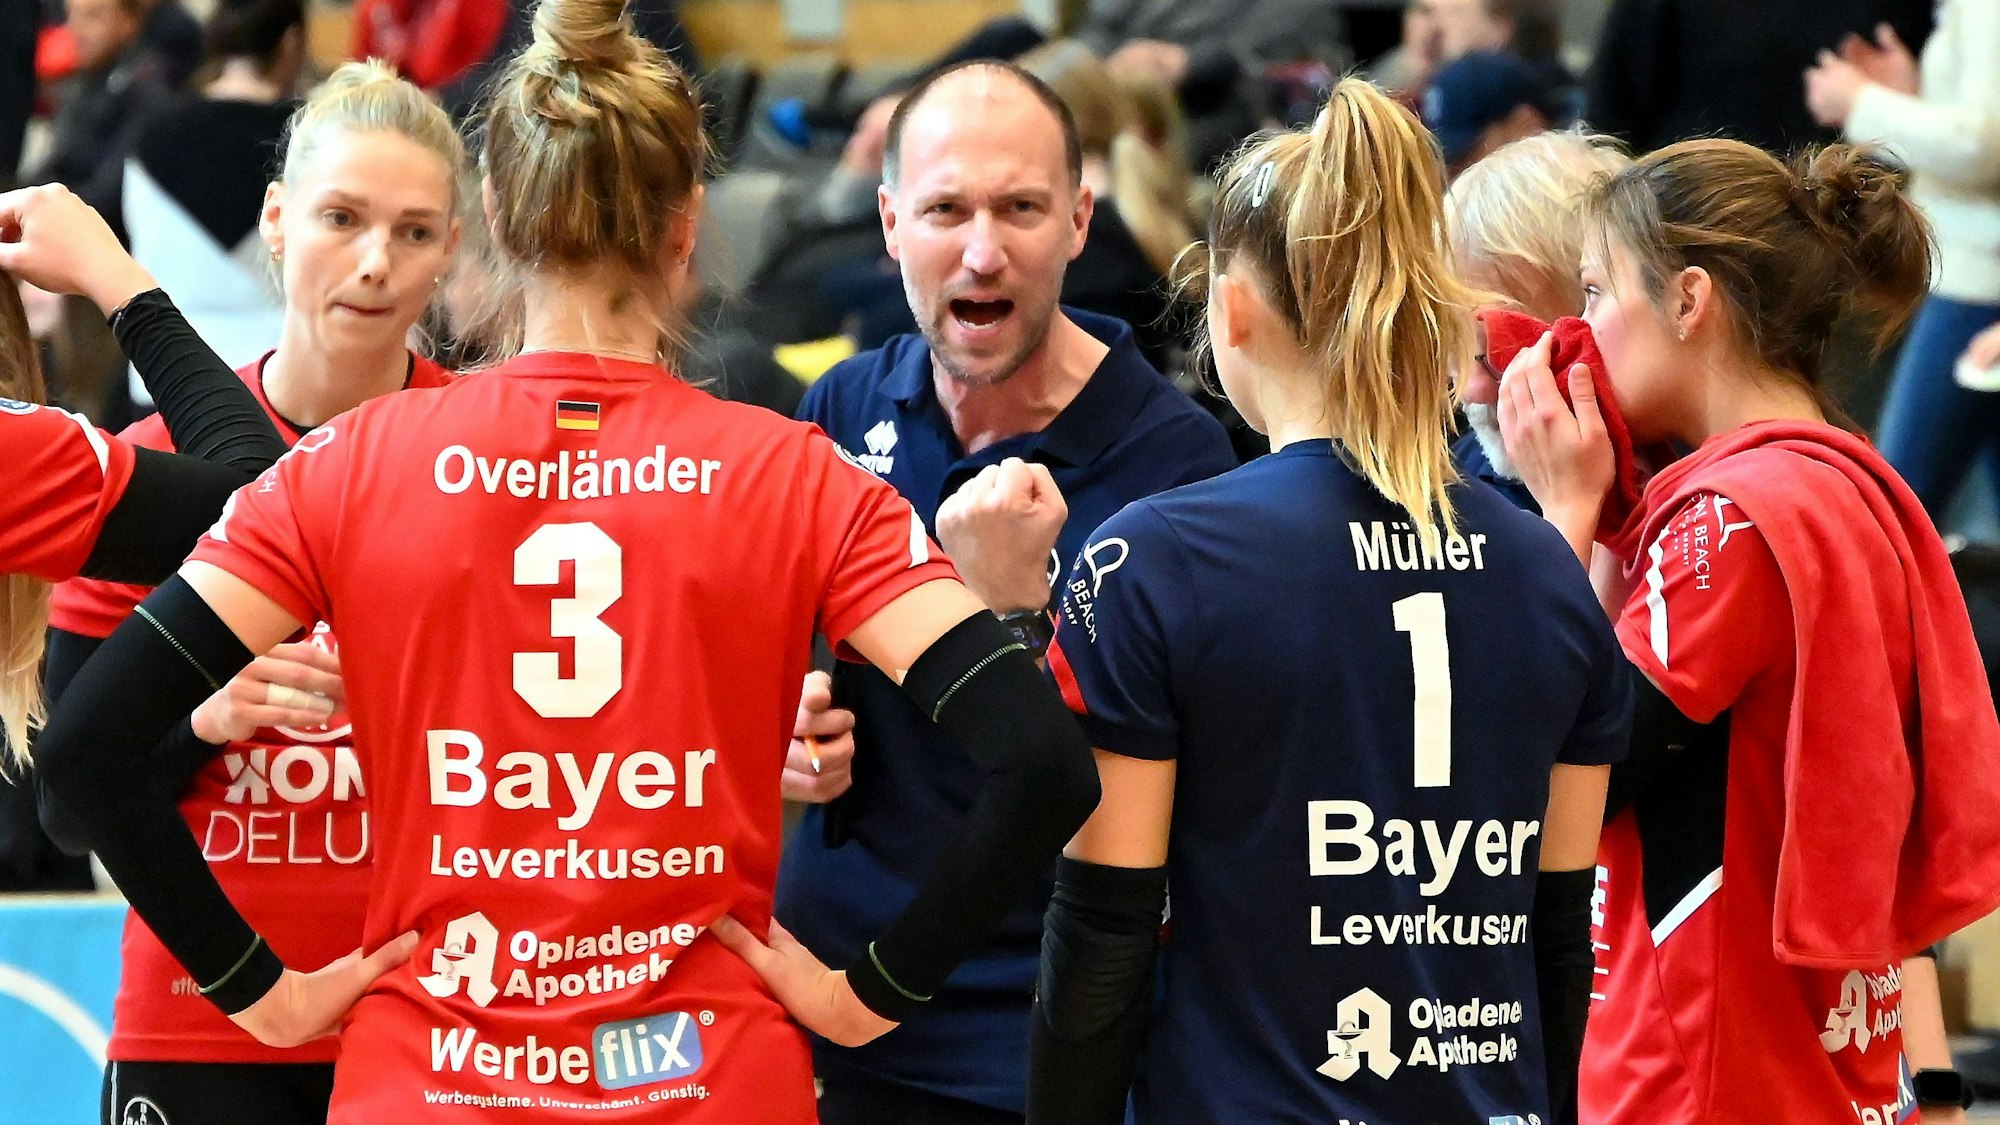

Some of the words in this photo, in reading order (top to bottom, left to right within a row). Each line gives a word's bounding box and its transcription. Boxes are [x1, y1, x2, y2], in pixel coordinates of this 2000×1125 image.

[434, 445, 721, 500] Overländer
[1694, 525, 1711, 590] BEACH
[512, 521, 623, 718] 3
[1392, 592, 1452, 787] 1
[426, 729, 716, 831] Bayer
[430, 834, 725, 879] Leverkusen
[1308, 800, 1540, 896] Bayer
[1310, 904, 1528, 945] Leverkusen
[1408, 997, 1522, 1034] Oladene
[1406, 1033, 1517, 1073] Aptheke
[424, 1089, 535, 1109] Werbesysteme.
[539, 1096, 644, 1111] Unverschämt.
[648, 1084, 711, 1103] Günstig.
